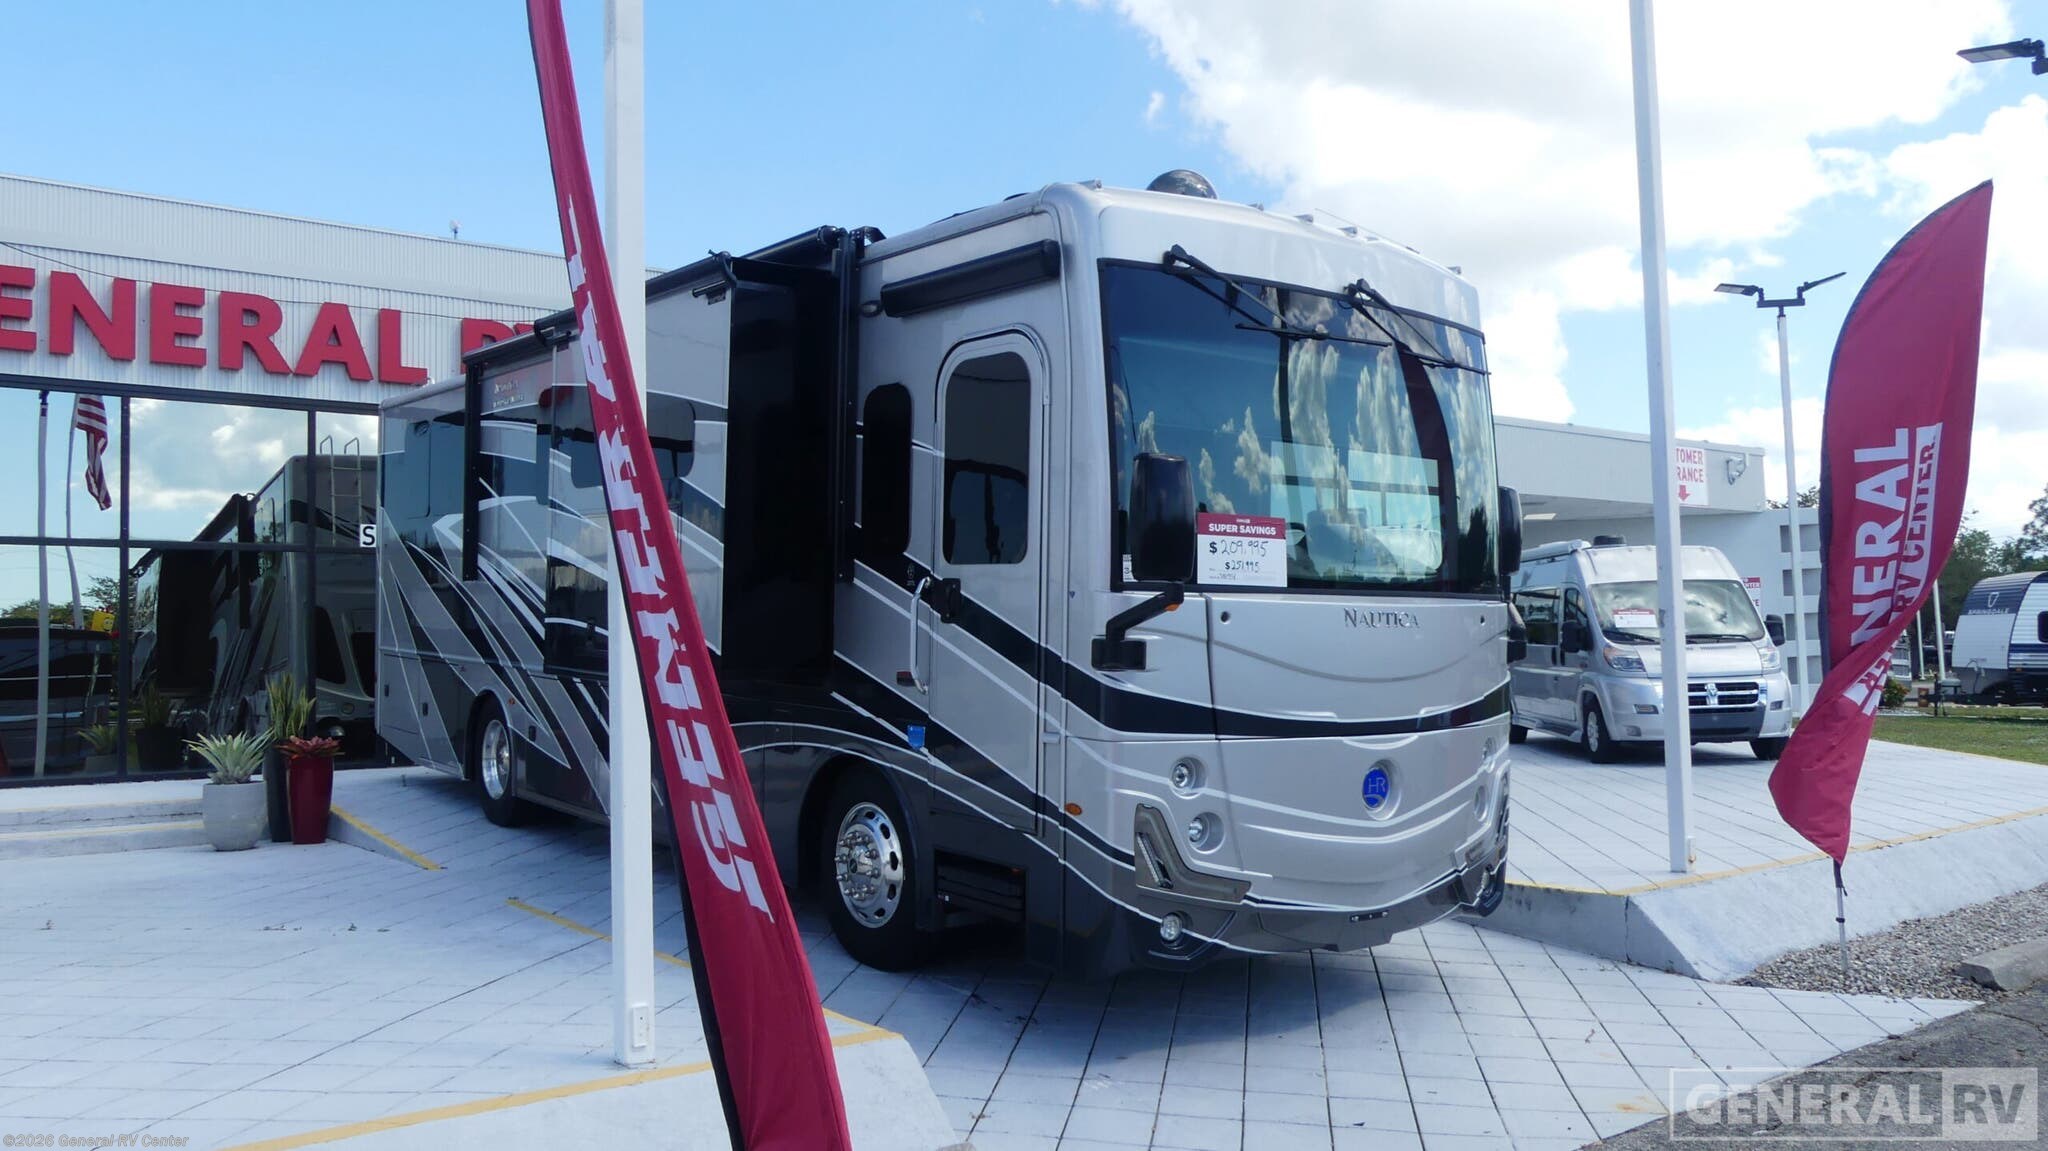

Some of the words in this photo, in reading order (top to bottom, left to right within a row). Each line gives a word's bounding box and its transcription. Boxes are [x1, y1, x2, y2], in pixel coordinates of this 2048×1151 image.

[1902, 443, 1935, 564] CENTER
[362, 525, 375, 546] S
[1208, 523, 1238, 533] SUPER
[1239, 525, 1276, 535] SAVINGS
[1343, 607, 1420, 628] NAUTICA
